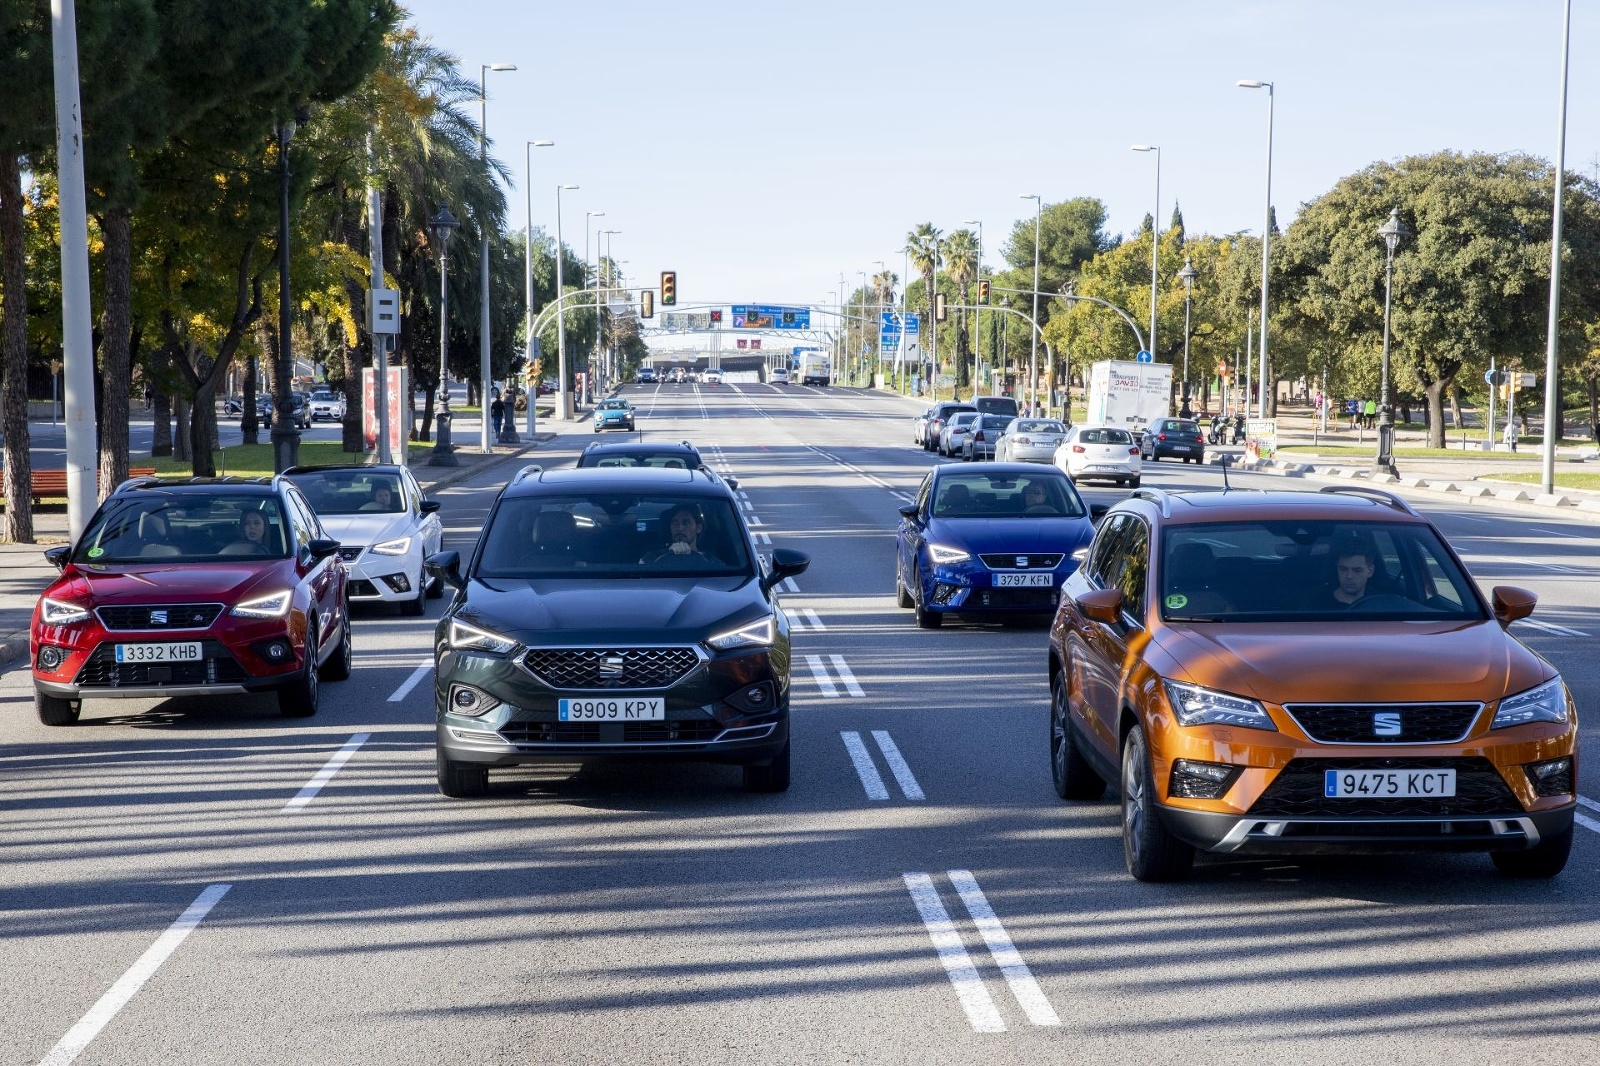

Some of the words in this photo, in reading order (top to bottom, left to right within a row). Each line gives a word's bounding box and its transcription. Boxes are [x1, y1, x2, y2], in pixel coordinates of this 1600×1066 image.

[1000, 575, 1027, 585] 3797
[1030, 575, 1050, 585] KFN
[127, 646, 165, 661] 3332
[169, 644, 197, 660] KHB
[572, 702, 618, 719] 9909
[625, 701, 658, 718] KPY
[1343, 774, 1399, 794] 9475
[1407, 773, 1449, 794] KCT
